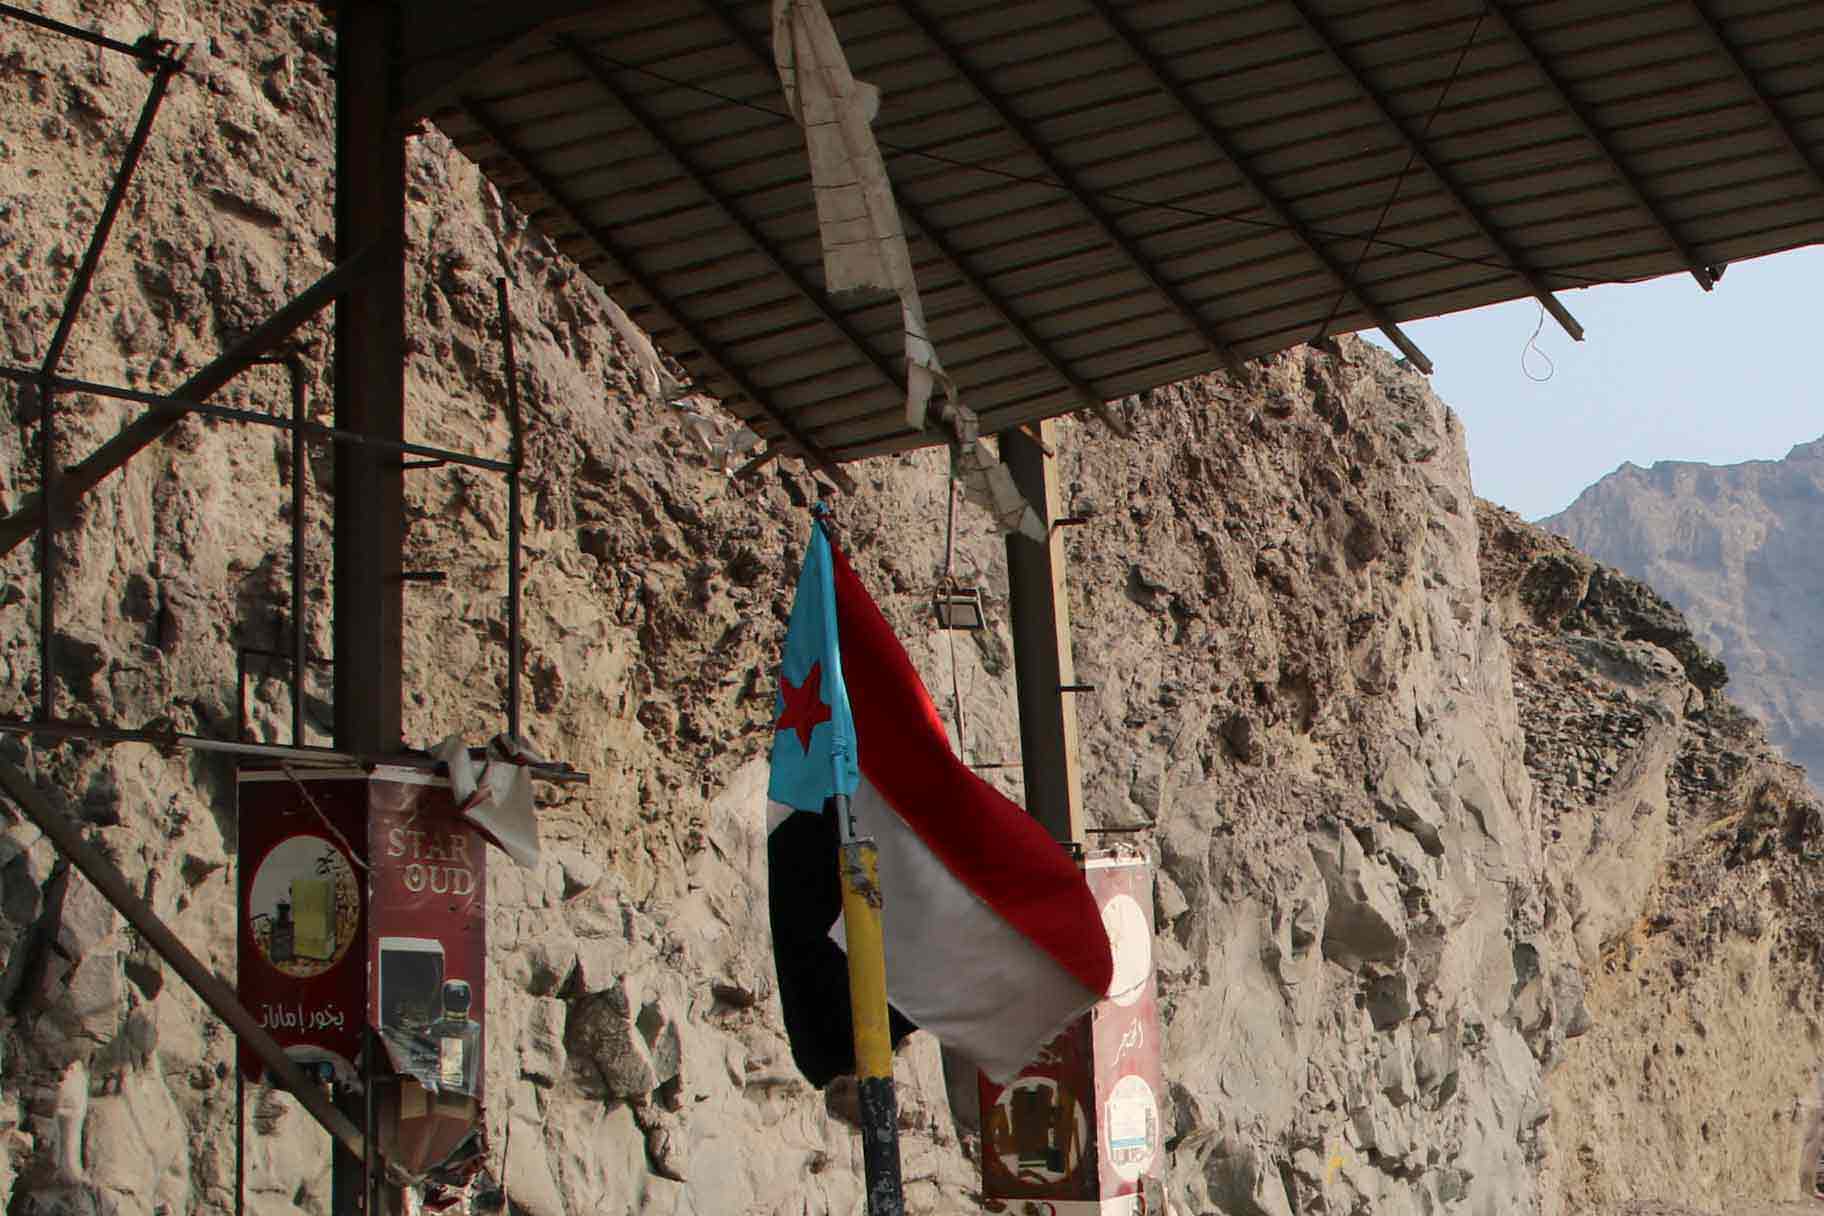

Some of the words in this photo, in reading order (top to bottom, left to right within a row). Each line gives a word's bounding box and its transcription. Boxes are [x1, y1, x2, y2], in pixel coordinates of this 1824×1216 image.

[386, 827, 467, 862] STAR
[403, 863, 474, 896] OUD
[308, 1003, 345, 1032] بخور
